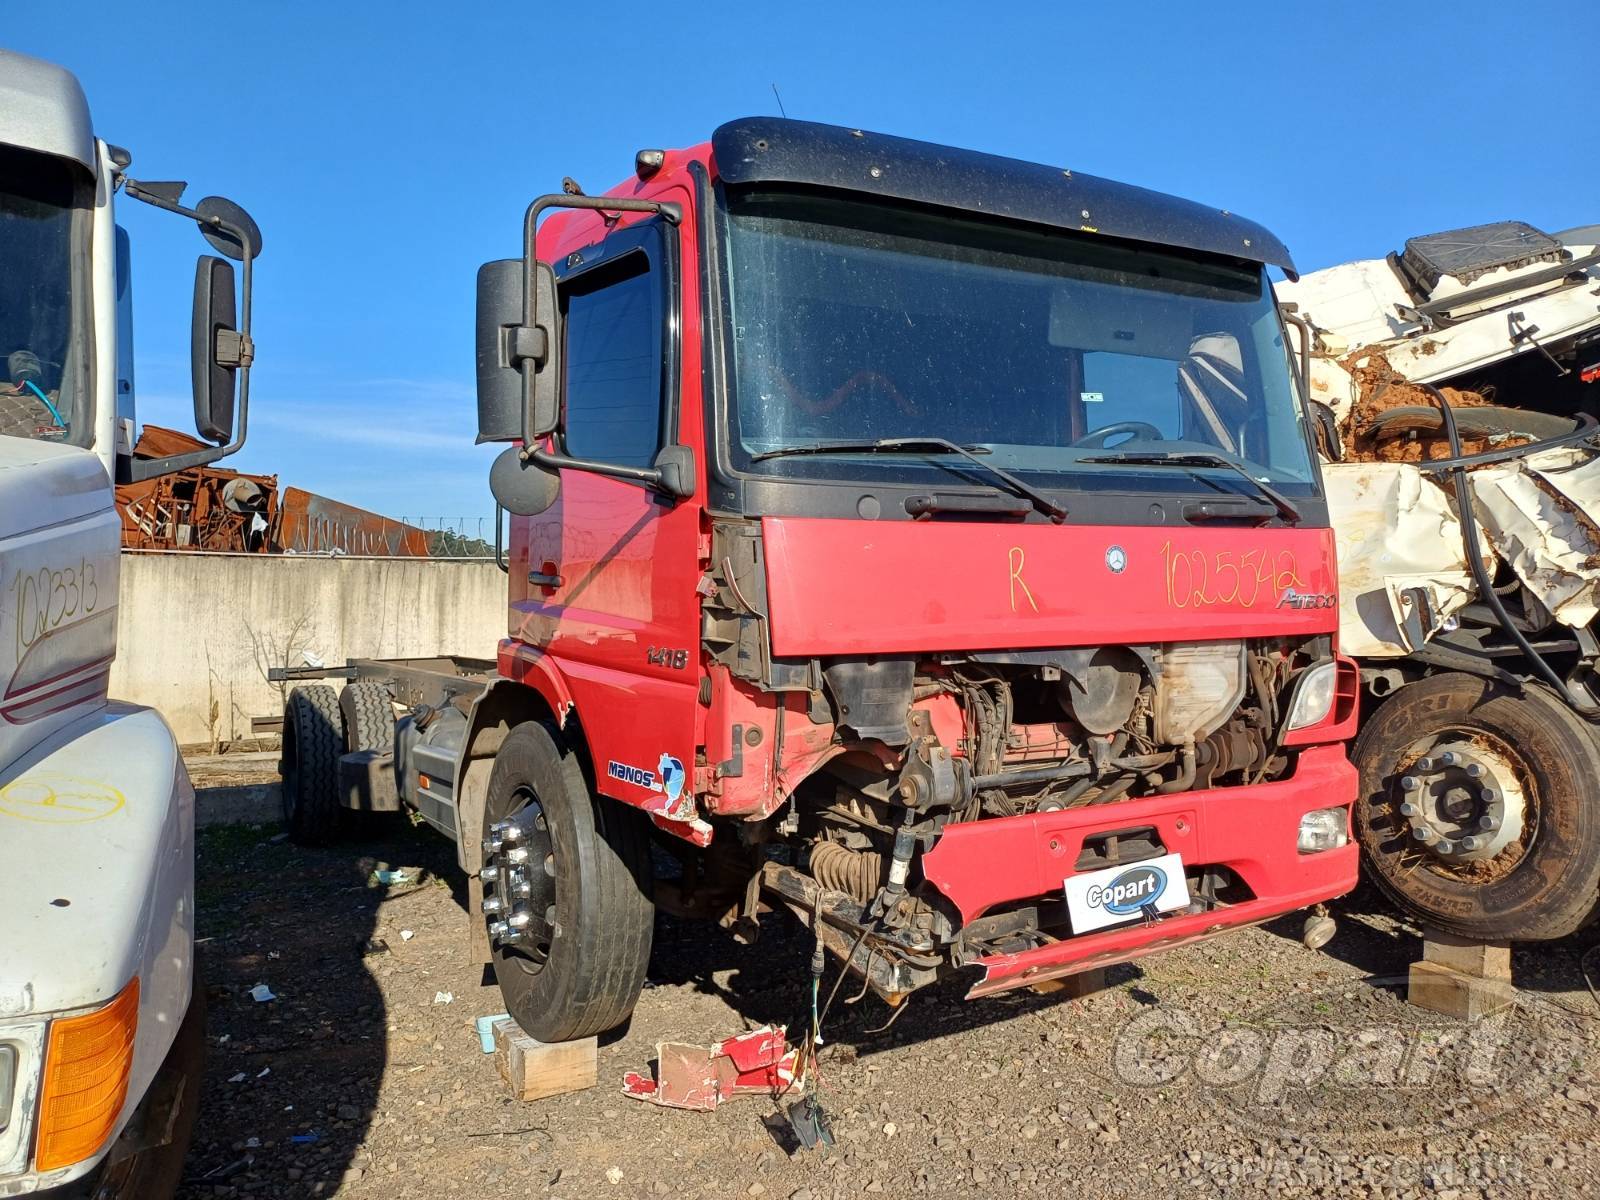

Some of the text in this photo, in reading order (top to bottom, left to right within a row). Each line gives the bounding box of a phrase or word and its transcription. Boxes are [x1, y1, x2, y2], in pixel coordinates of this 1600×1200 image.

[1008, 546, 1040, 614] R
[1160, 540, 1307, 608] 1025542
[10, 557, 98, 664] 1023313
[647, 645, 689, 670] 1418
[1086, 872, 1156, 909] Copart
